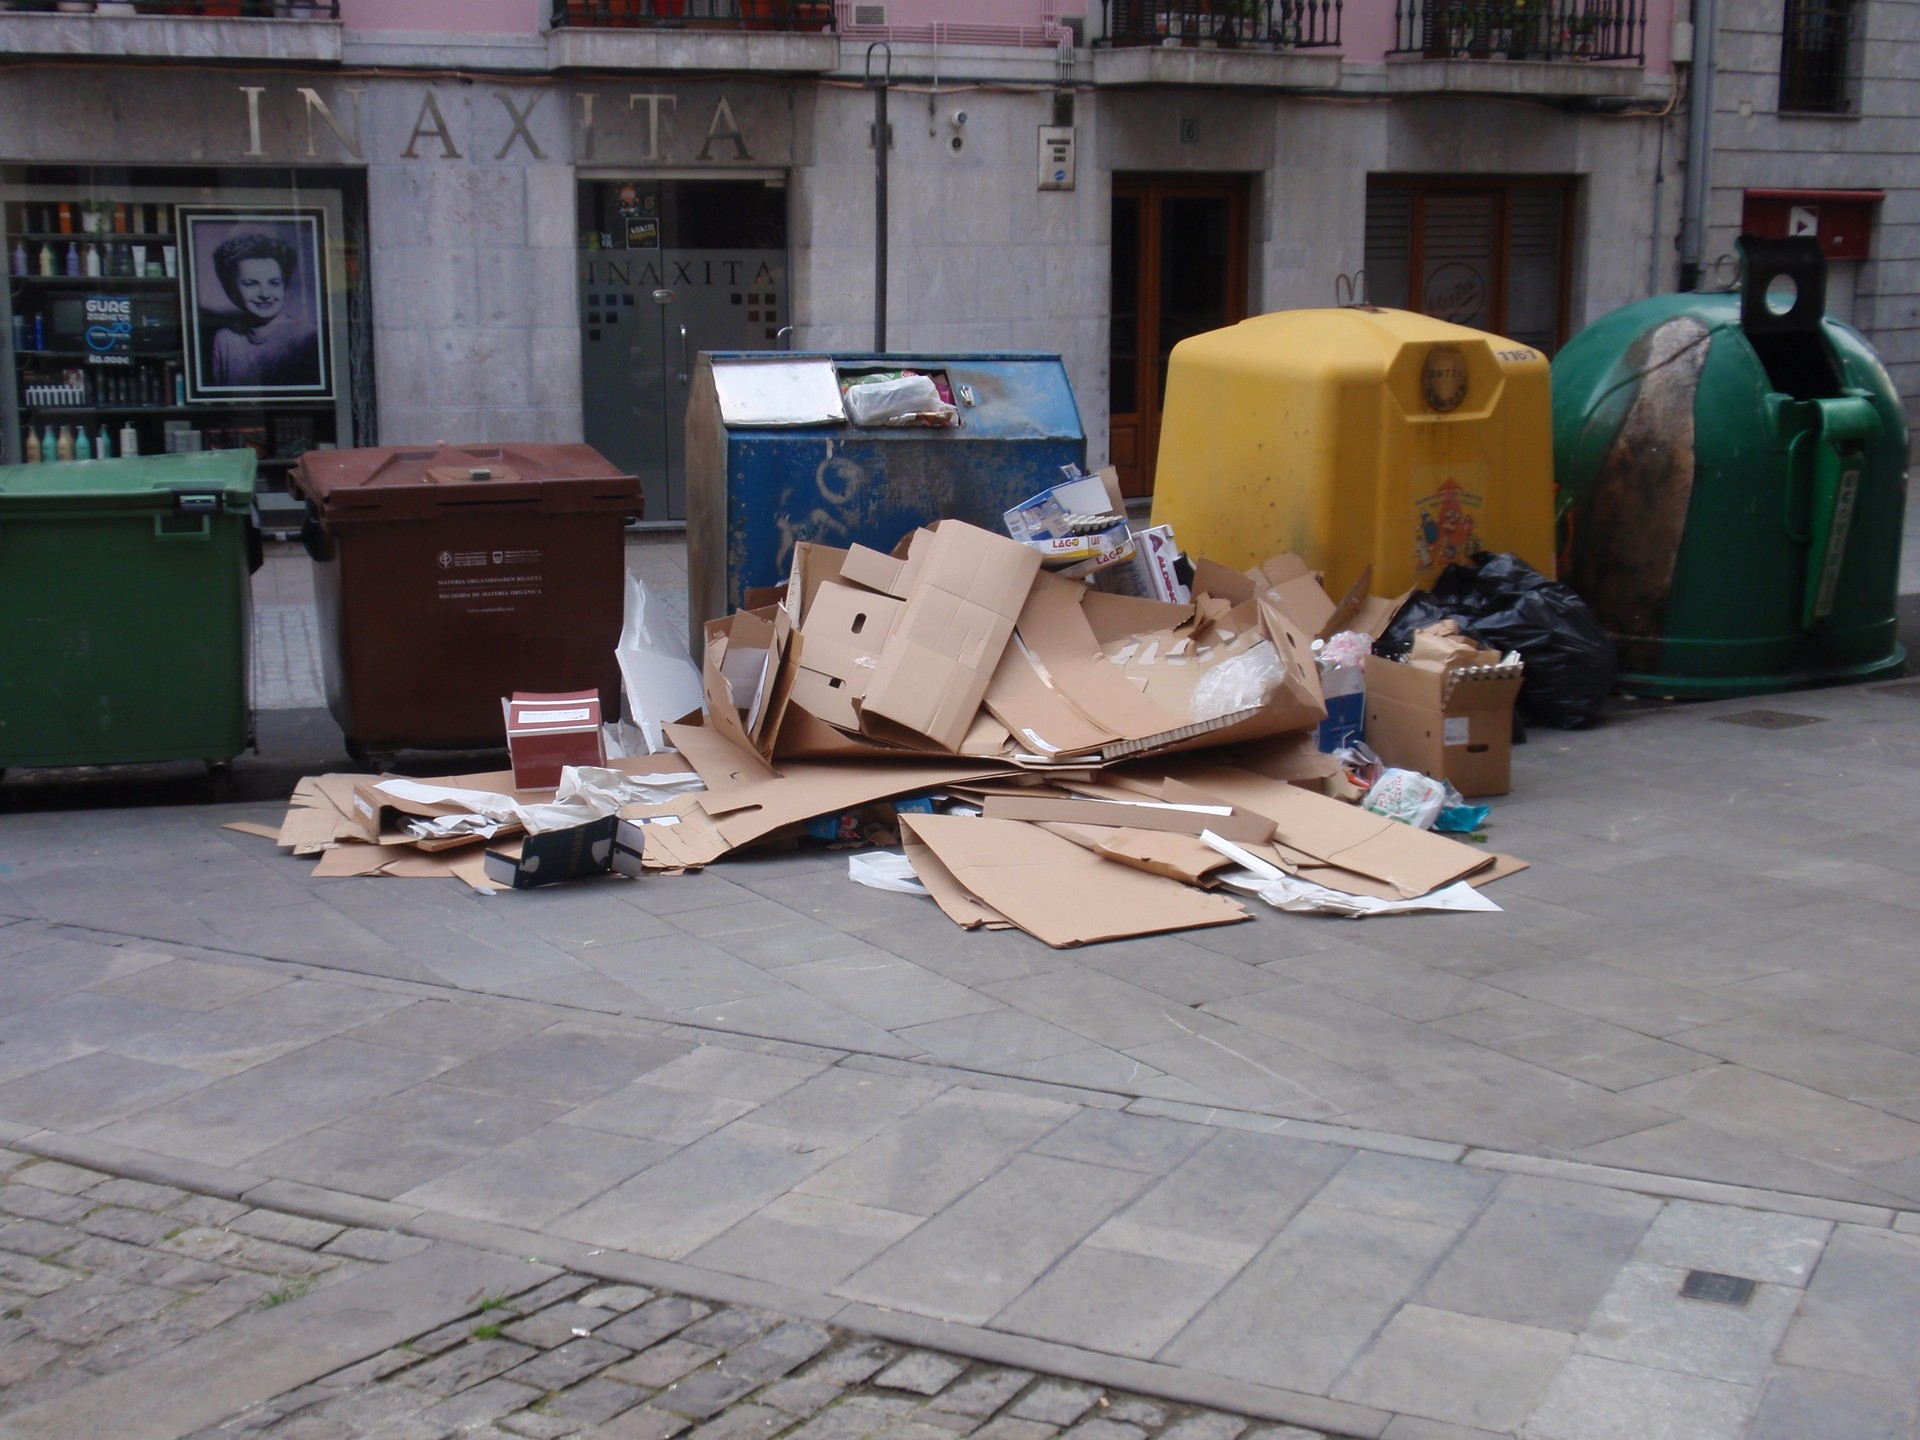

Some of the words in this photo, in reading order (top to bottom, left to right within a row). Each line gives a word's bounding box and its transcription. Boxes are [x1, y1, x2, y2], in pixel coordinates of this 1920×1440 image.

[238, 86, 755, 161] INAXITA
[586, 260, 777, 286] INAXITA
[86, 300, 131, 313] GURE
[1052, 538, 1080, 549] LAGO
